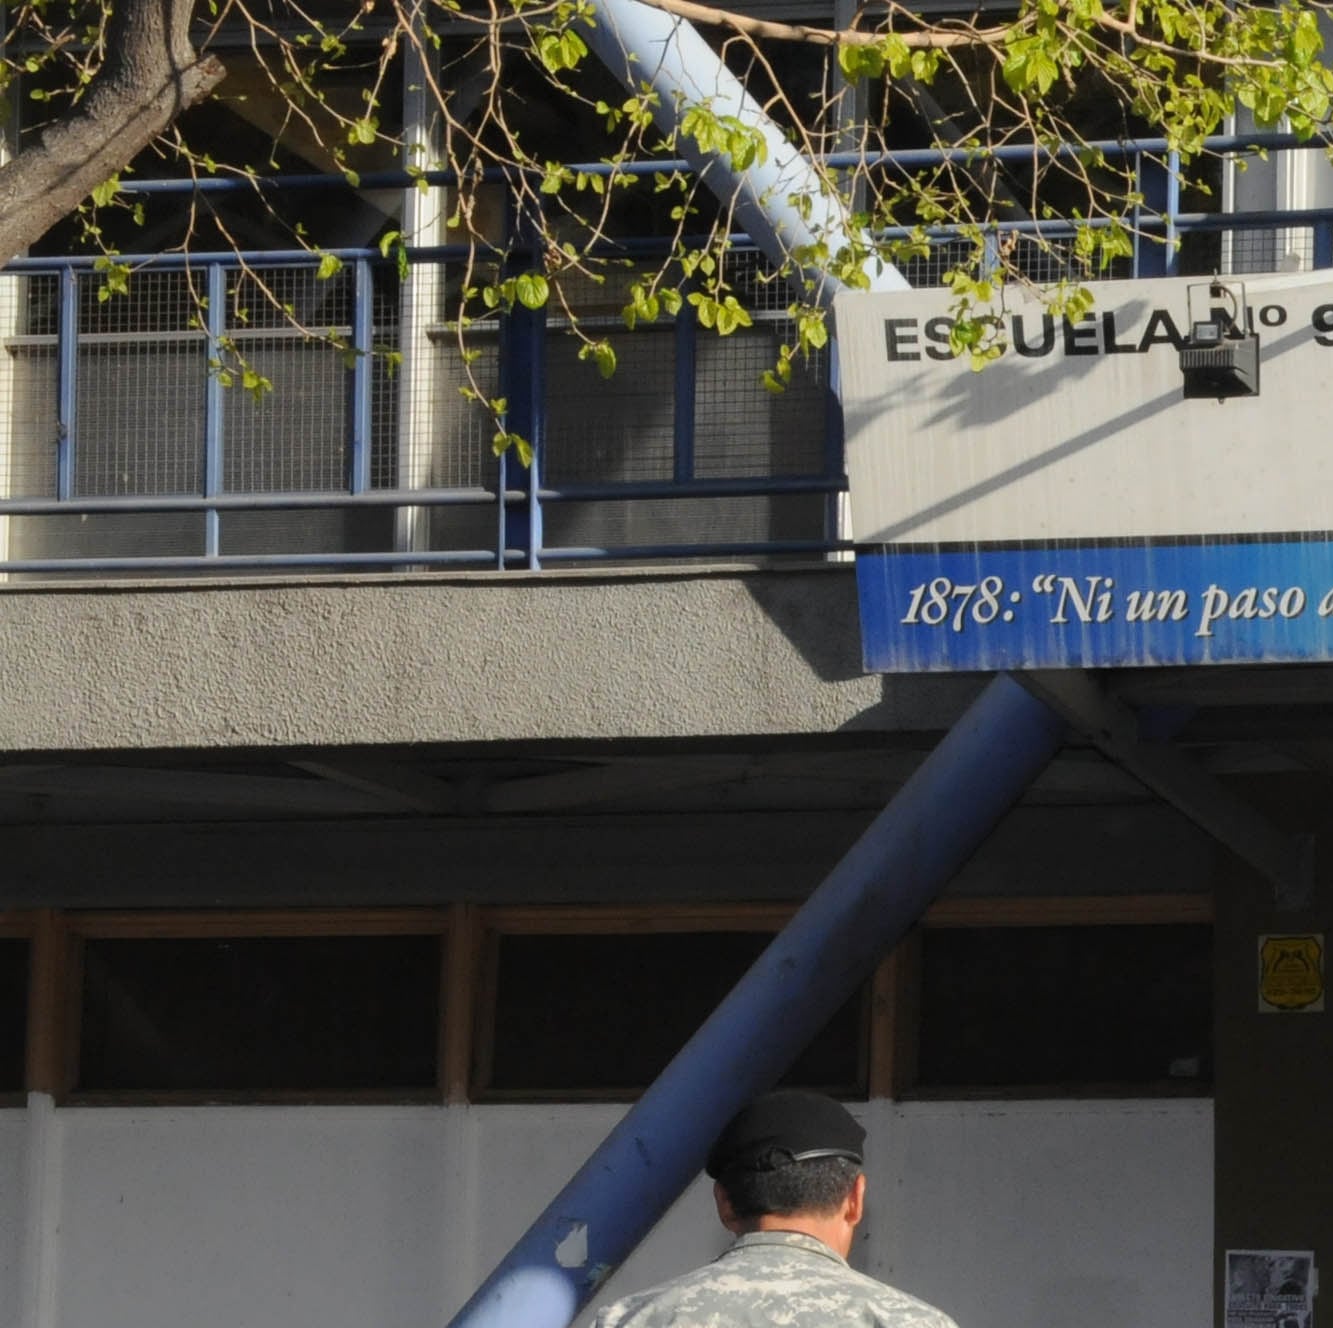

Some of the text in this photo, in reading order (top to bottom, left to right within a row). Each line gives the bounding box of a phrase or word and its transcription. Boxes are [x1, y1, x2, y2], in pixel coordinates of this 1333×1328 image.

[902, 577, 1022, 632] 1878:
[1127, 590, 1188, 623] un
[1195, 584, 1306, 637] paso
